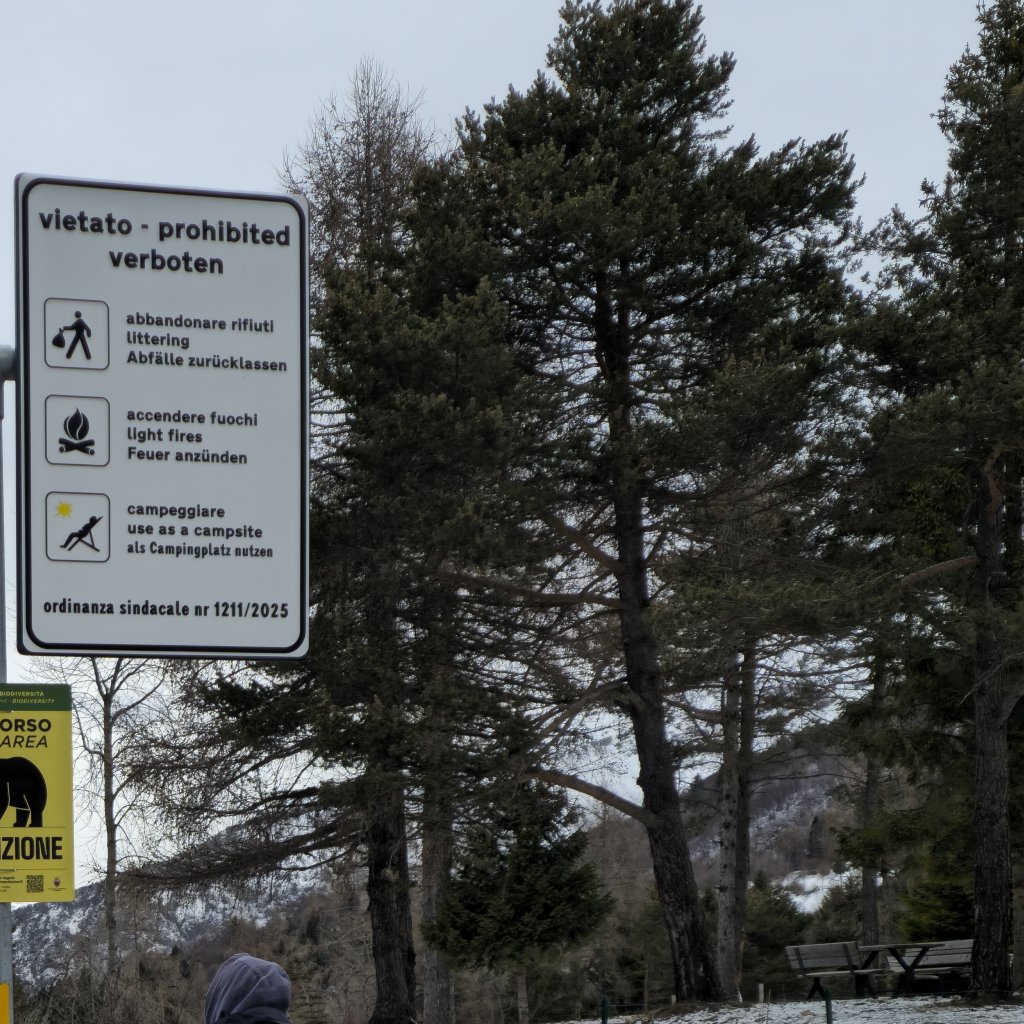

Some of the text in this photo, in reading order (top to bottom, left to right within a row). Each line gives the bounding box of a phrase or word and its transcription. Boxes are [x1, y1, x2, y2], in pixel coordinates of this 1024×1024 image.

[39, 208, 132, 235] vietato
[159, 220, 290, 246] prohibited
[109, 249, 223, 274] verboten
[126, 312, 273, 332] abbandonare rifiuti
[126, 331, 189, 349] littering
[126, 351, 286, 371] Abfälle zurücklassen
[127, 410, 257, 425] accendere fuochi
[128, 427, 202, 443] light fires
[128, 447, 247, 463] Feuer anzünden
[128, 505, 225, 519] campeggiare
[128, 525, 262, 539] use as a campsite
[128, 541, 272, 558] als Campingplatz nutzen
[44, 598, 288, 618] ordinanza sindacale nr 1211/2025
[0, 719, 51, 732] ORSO
[0, 735, 47, 748] AREA
